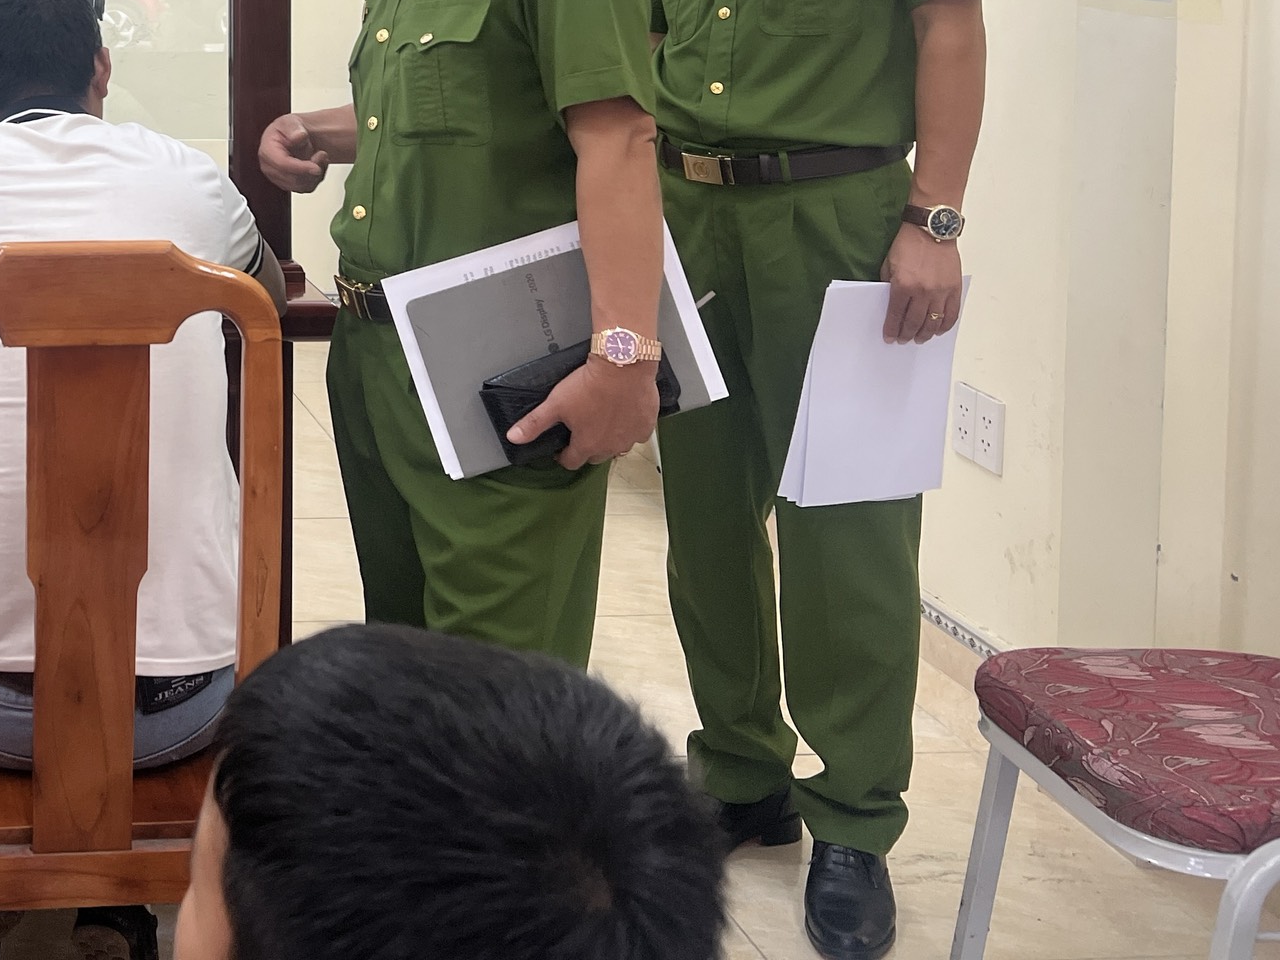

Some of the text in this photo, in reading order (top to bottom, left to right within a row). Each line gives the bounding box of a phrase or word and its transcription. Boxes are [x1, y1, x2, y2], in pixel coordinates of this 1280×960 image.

[525, 273, 555, 342] LG Display 2020
[154, 674, 204, 703] JEANS
